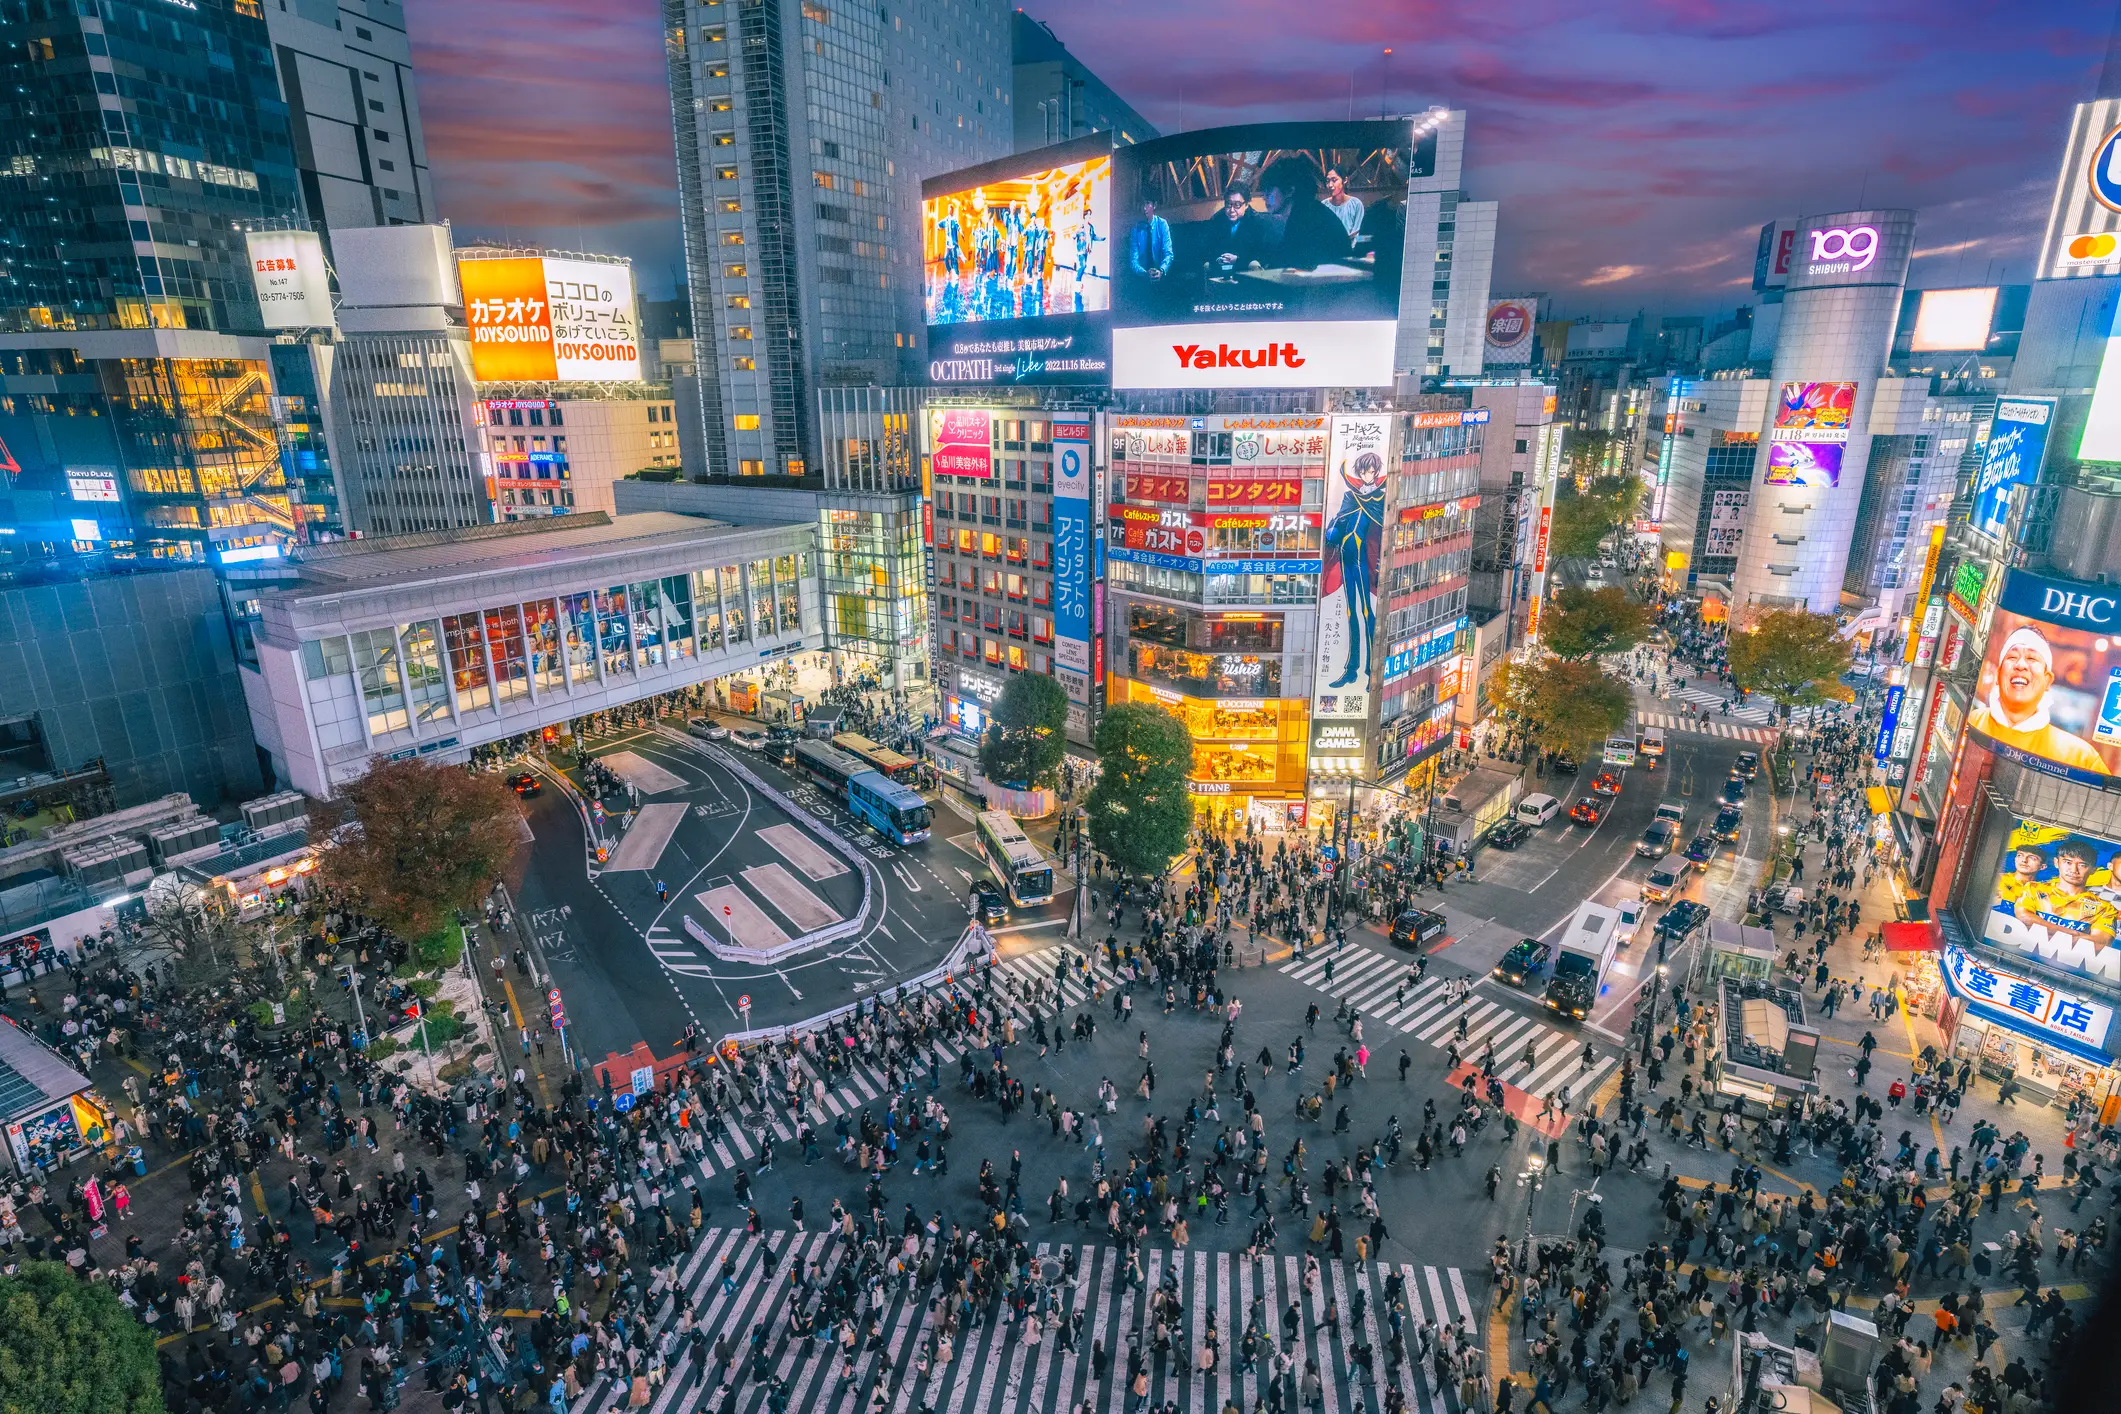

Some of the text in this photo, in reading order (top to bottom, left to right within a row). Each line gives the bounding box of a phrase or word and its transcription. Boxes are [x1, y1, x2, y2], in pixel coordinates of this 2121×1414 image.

[1811, 226, 1879, 272] 109
[256, 258, 297, 272] 広告募集
[1808, 263, 1849, 275] SHIBUYA
[2066, 258, 2110, 266] mastercard
[549, 280, 612, 303] ココロの
[470, 297, 545, 324] カラオケ
[552, 302, 632, 326] ボリューム、
[1193, 302, 1284, 313] 手を抜くということはないですよ
[474, 325, 550, 344] JOYSOUND
[555, 324, 635, 342] あげていこう。
[556, 342, 637, 362] JOYSOUND
[1172, 342, 1306, 370] Yakult
[930, 359, 993, 381] OCTPATH
[1015, 352, 1044, 381] Like
[1045, 360, 1078, 371] 2022.11.16
[1080, 358, 1106, 370] Release
[489, 401, 514, 409] カラオケ
[956, 416, 988, 428] 品川スキン
[1116, 416, 1186, 429] しゃぶしゃぶバイキング
[1223, 417, 1325, 429] しゃぶしゃぶバイキング
[1340, 422, 1382, 436] コードギアス
[956, 428, 984, 440] クリニック
[1056, 426, 1086, 437] 当ビル5F
[1772, 428, 1803, 440] 11.18
[1113, 438, 1125, 450] 9F
[1148, 436, 1188, 455] しゃぶ葉
[1265, 436, 1324, 455] しゃぶ葉
[941, 455, 988, 472] 品川美容外科
[1548, 428, 1560, 482] BIC CAMERA
[1057, 480, 1086, 492] eyecity
[1127, 478, 1188, 498] プライス
[1208, 482, 1299, 500] コンタクト
[1124, 509, 1192, 528] Caféレストラン ガスト
[1214, 514, 1312, 531] Caféレストラン ガスト
[1112, 526, 1125, 538] 7F
[1128, 528, 1144, 536] Café
[1144, 528, 1182, 550] ガスト
[1058, 516, 1072, 616] アイシティ
[1074, 518, 1084, 618] コンタクトの
[1132, 551, 1186, 568] 英会話イーオン
[1242, 562, 1320, 572] 英会話イーオン
[2041, 588, 2116, 623] DHC
[446, 623, 490, 638] impossibe
[501, 616, 533, 627] nothng
[1458, 616, 1467, 629] 4F
[1062, 641, 1082, 651] CONTACT
[1066, 648, 1078, 657] LENS
[1058, 653, 1086, 665] SPECIALISTS
[1384, 652, 1410, 679] AGA
[960, 672, 1003, 698] サンドラッ
[1150, 686, 1183, 702] L'OCCITANE
[1890, 690, 1900, 714] MIZUHO
[1216, 700, 1265, 708] L'OCCITANE
[1432, 700, 1452, 722] LUSH
[1322, 726, 1355, 738] DMM
[1315, 738, 1360, 750] GAMES
[2008, 746, 2069, 776] DHC Channel
[2047, 916, 2086, 932] にしたん
[1984, 908, 2120, 982] DMM
[2050, 1023, 2095, 1044] BOOKS TAISEIDO
